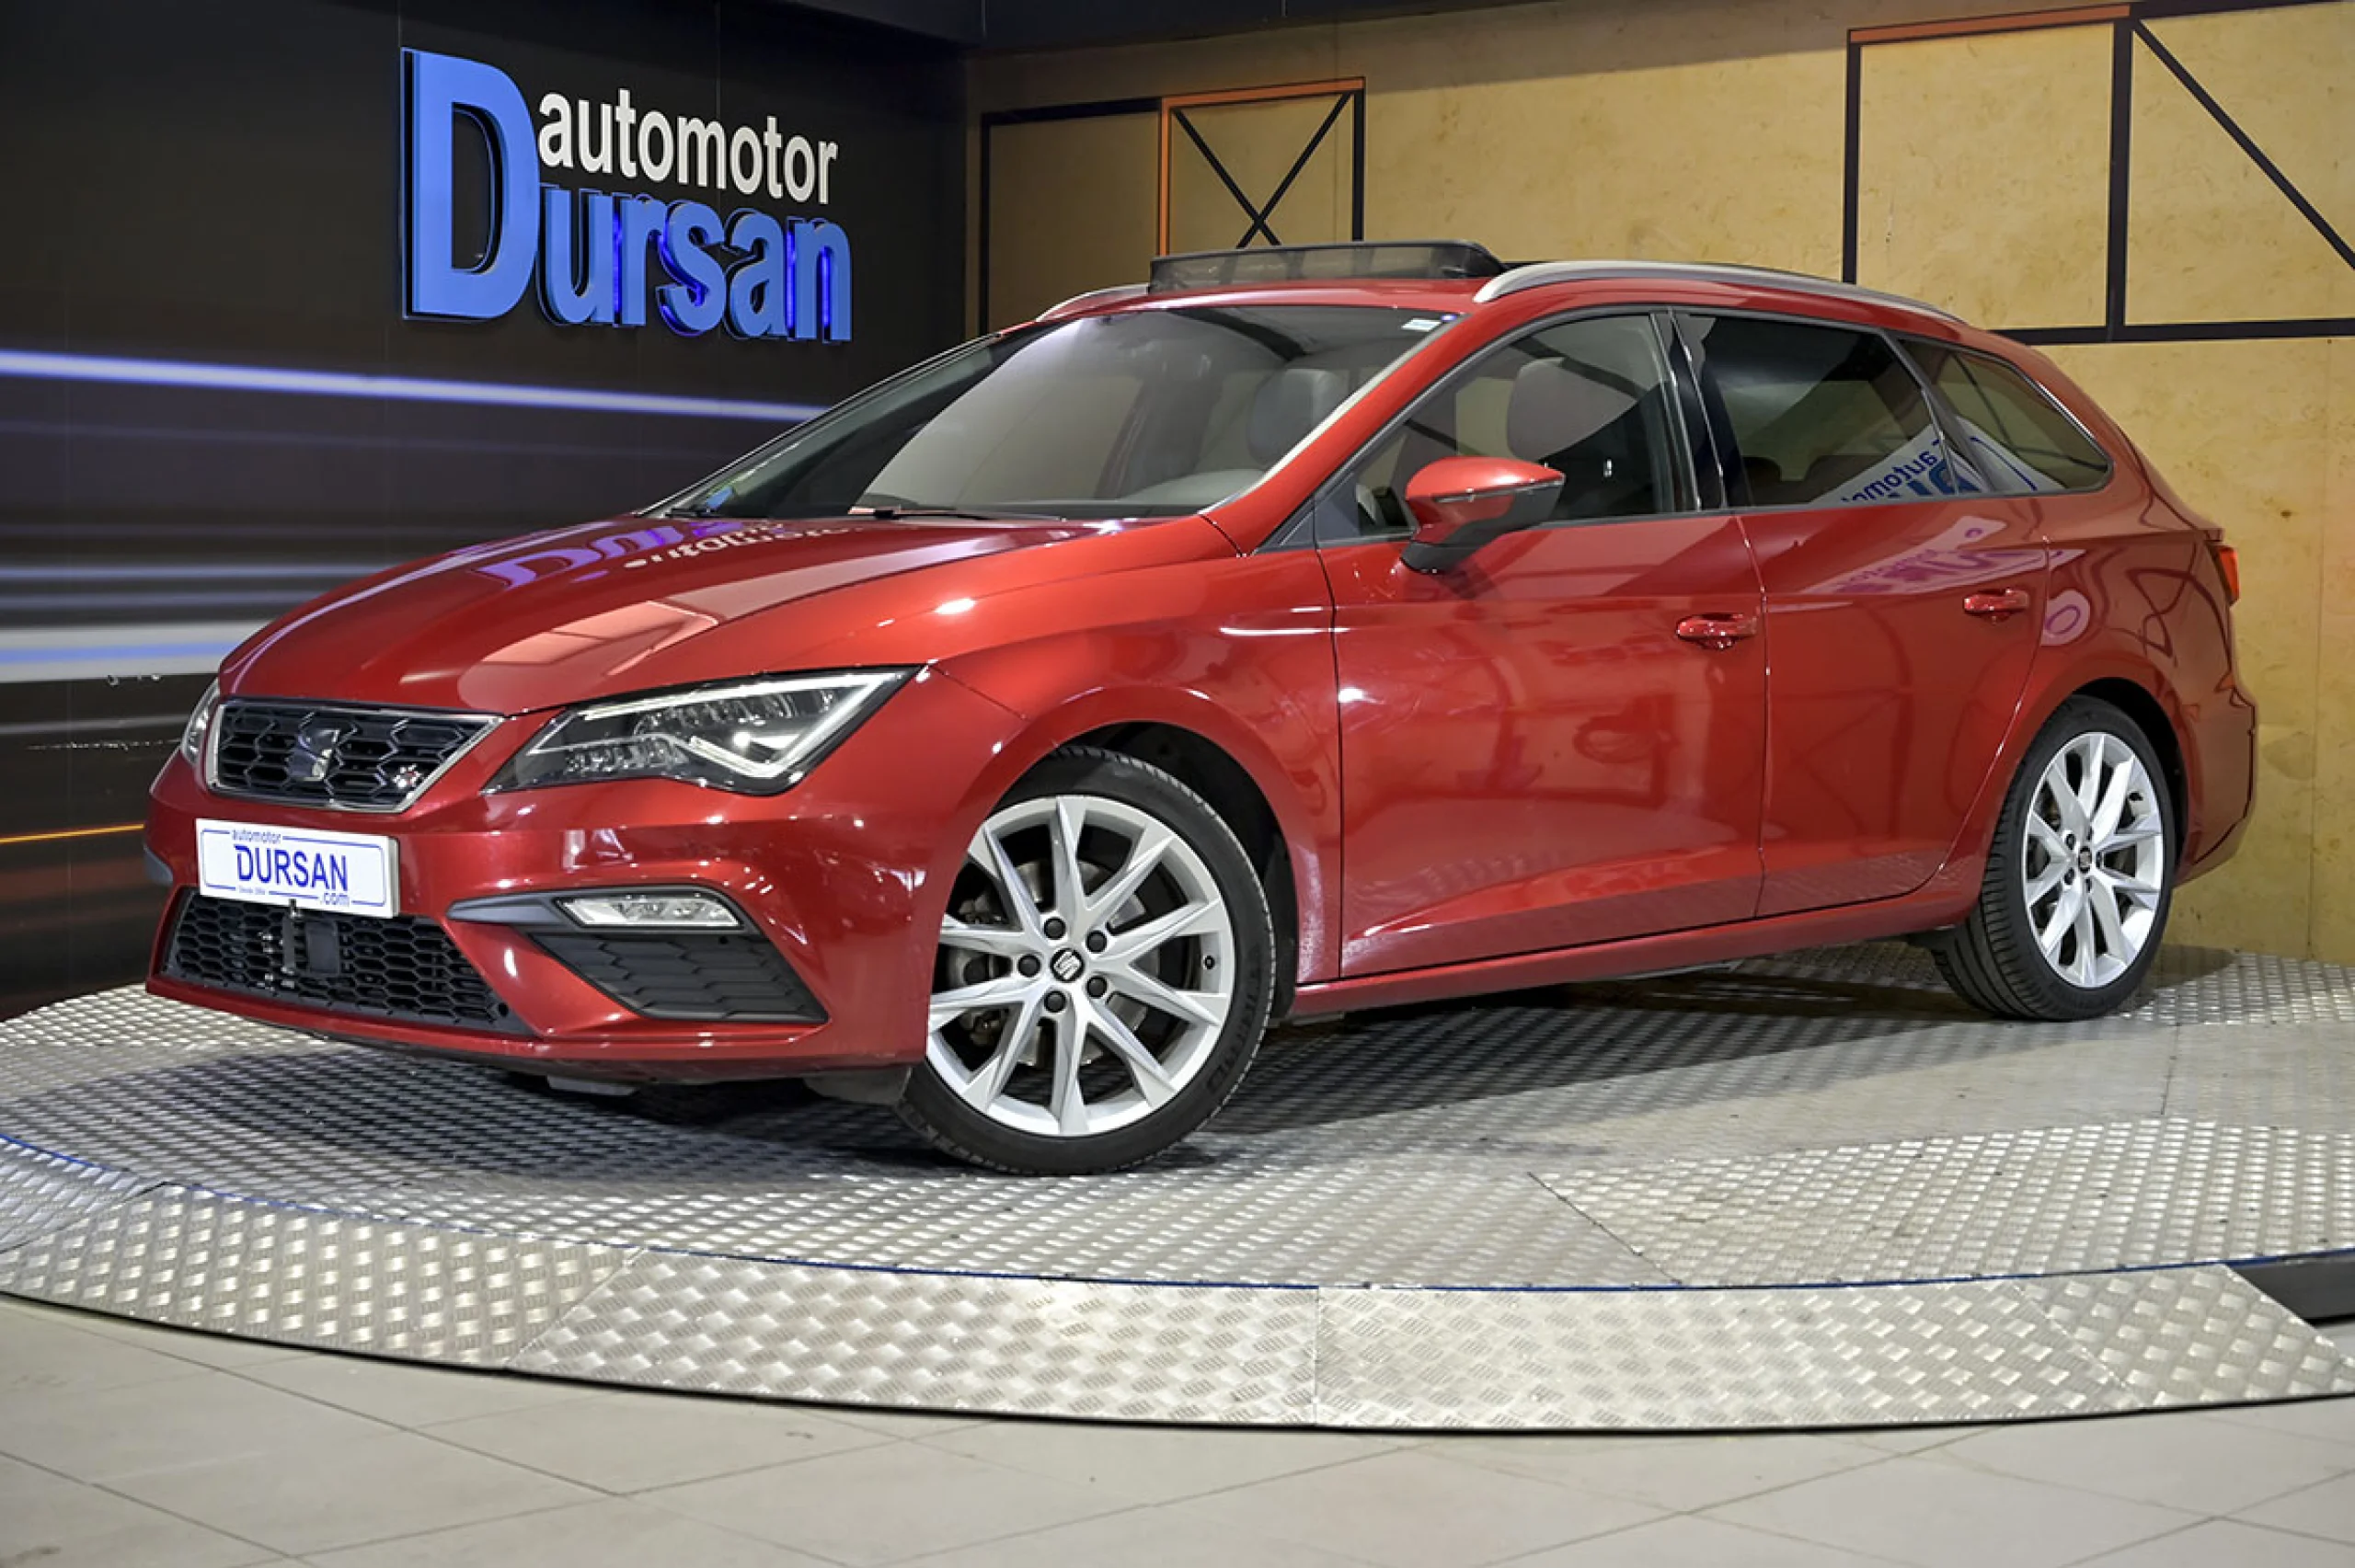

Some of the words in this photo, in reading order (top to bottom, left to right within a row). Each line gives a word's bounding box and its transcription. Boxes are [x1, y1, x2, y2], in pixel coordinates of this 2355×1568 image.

[401, 47, 852, 344] Dursan
[538, 88, 838, 204] automotor
[234, 844, 349, 891] DURSAN
